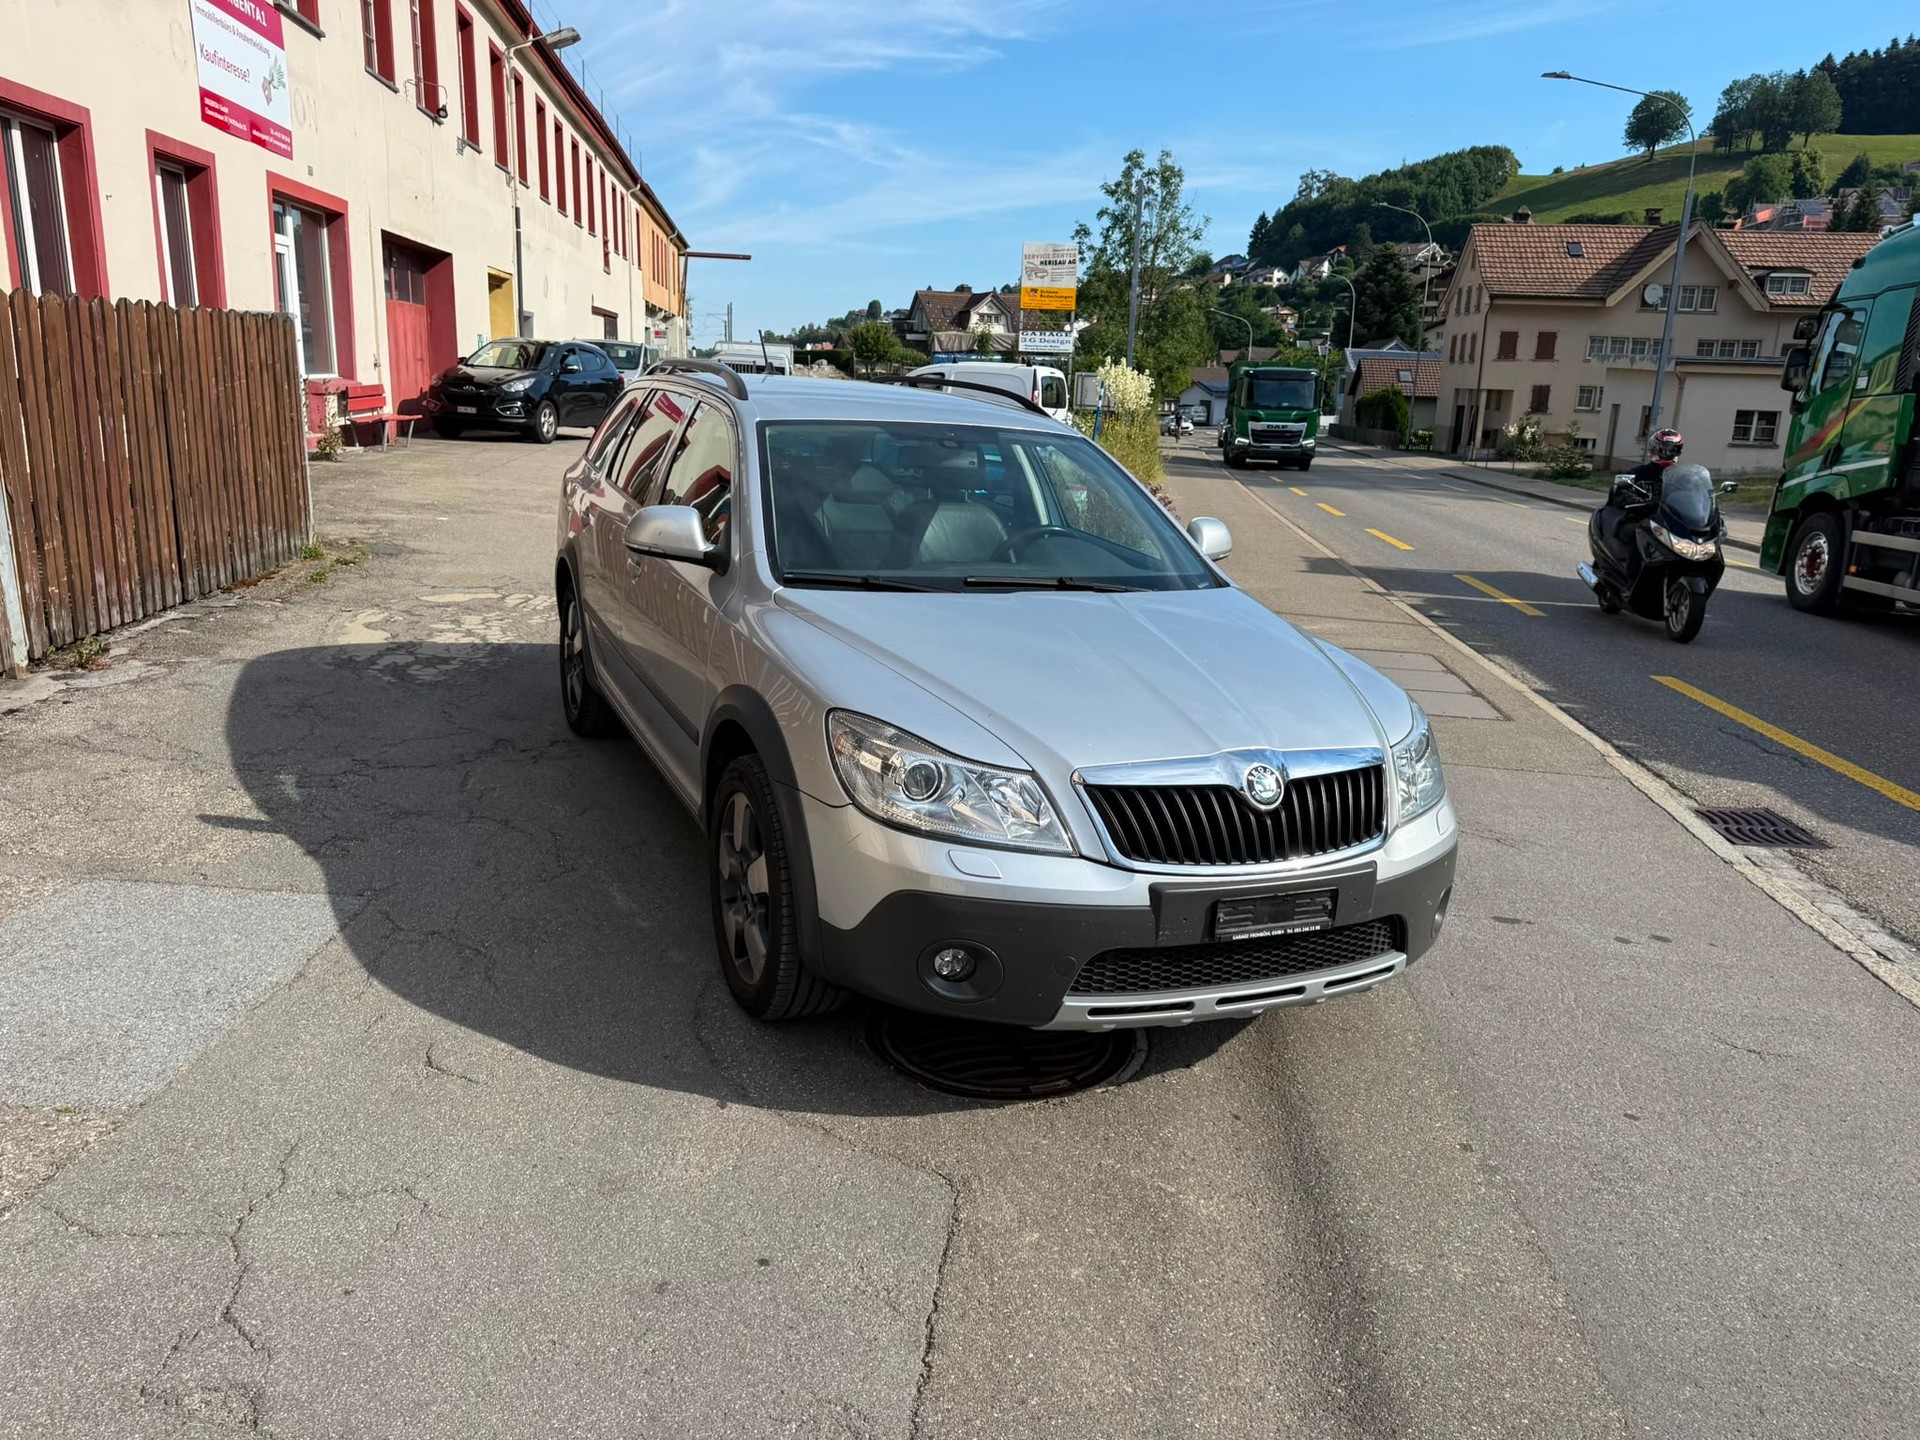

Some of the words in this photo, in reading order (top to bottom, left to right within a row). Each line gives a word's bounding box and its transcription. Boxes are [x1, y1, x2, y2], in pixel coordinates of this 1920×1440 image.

[226, 0, 267, 27] GENTA1
[199, 42, 251, 84] Kaufinteresse?
[1039, 337, 1071, 345] Design
